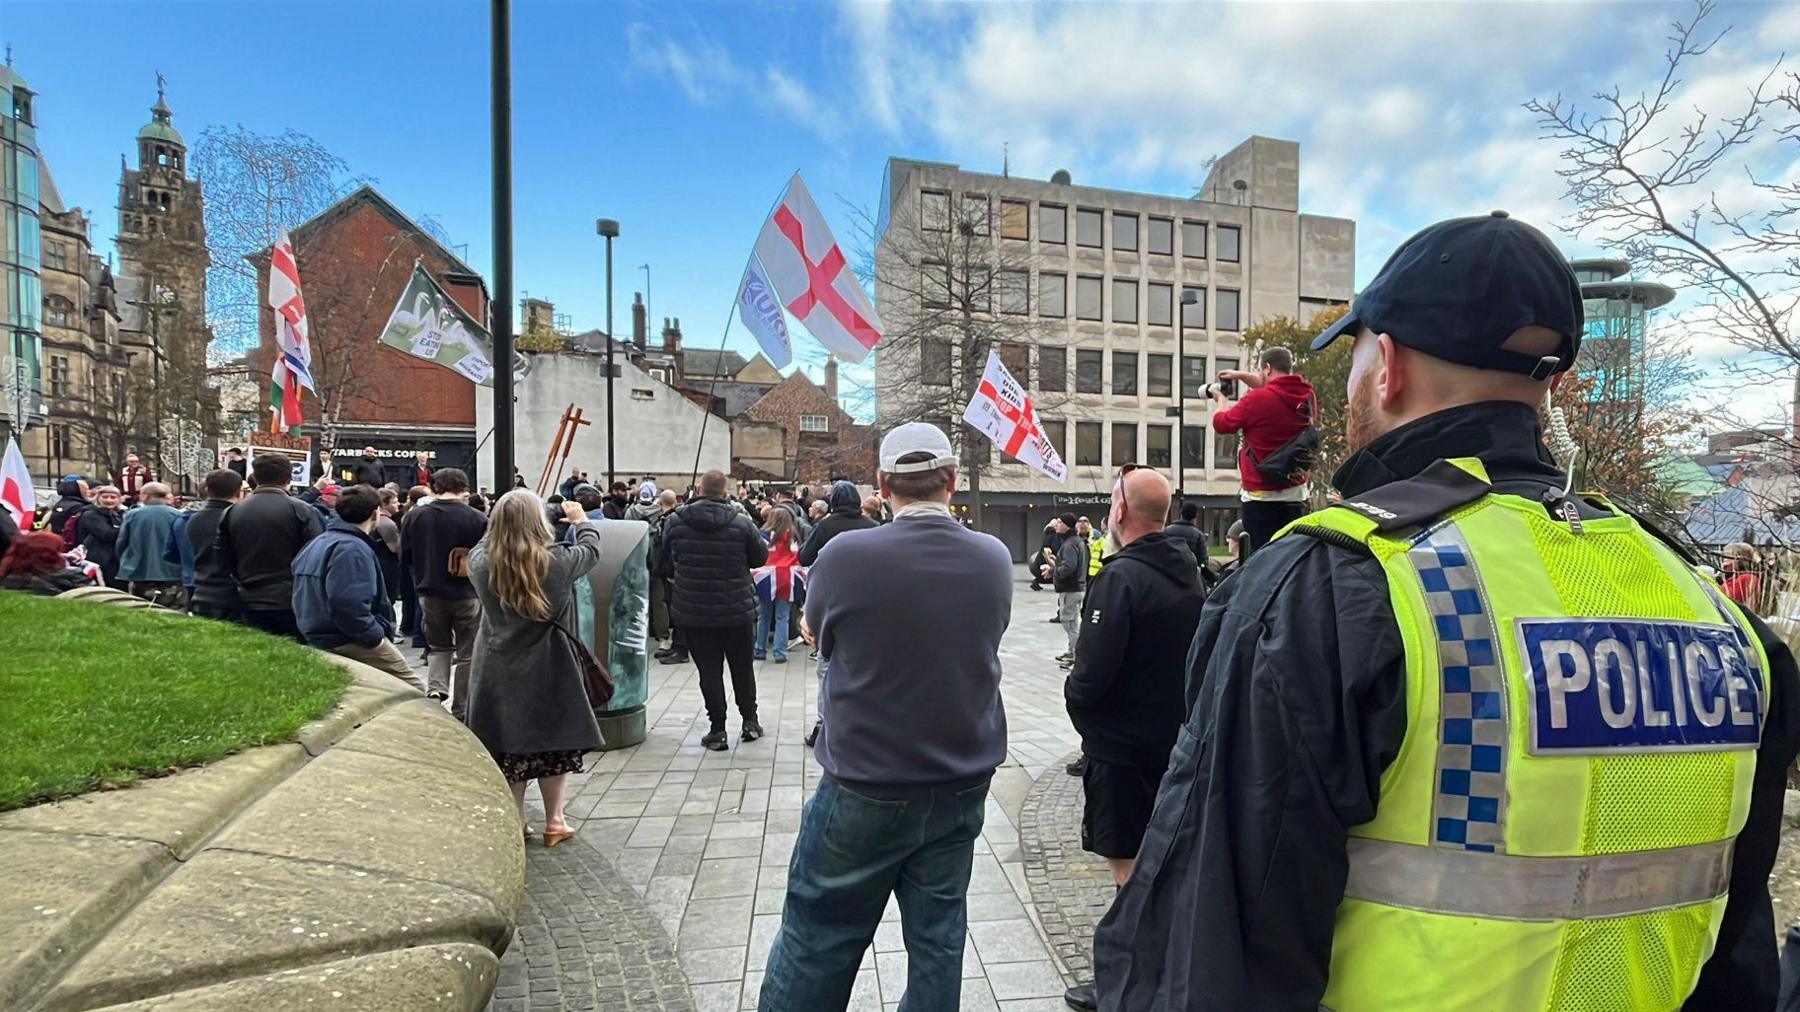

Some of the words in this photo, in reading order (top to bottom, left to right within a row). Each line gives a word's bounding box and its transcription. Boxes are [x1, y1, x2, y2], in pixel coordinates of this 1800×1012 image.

[427, 331, 442, 342] STO
[419, 339, 440, 350] EATIN
[1001, 388, 1022, 408] KIDS
[331, 448, 393, 458] TARBCKS
[394, 449, 437, 459] COFE
[1069, 496, 1100, 504] Head
[1540, 638, 1754, 729] POLICE
